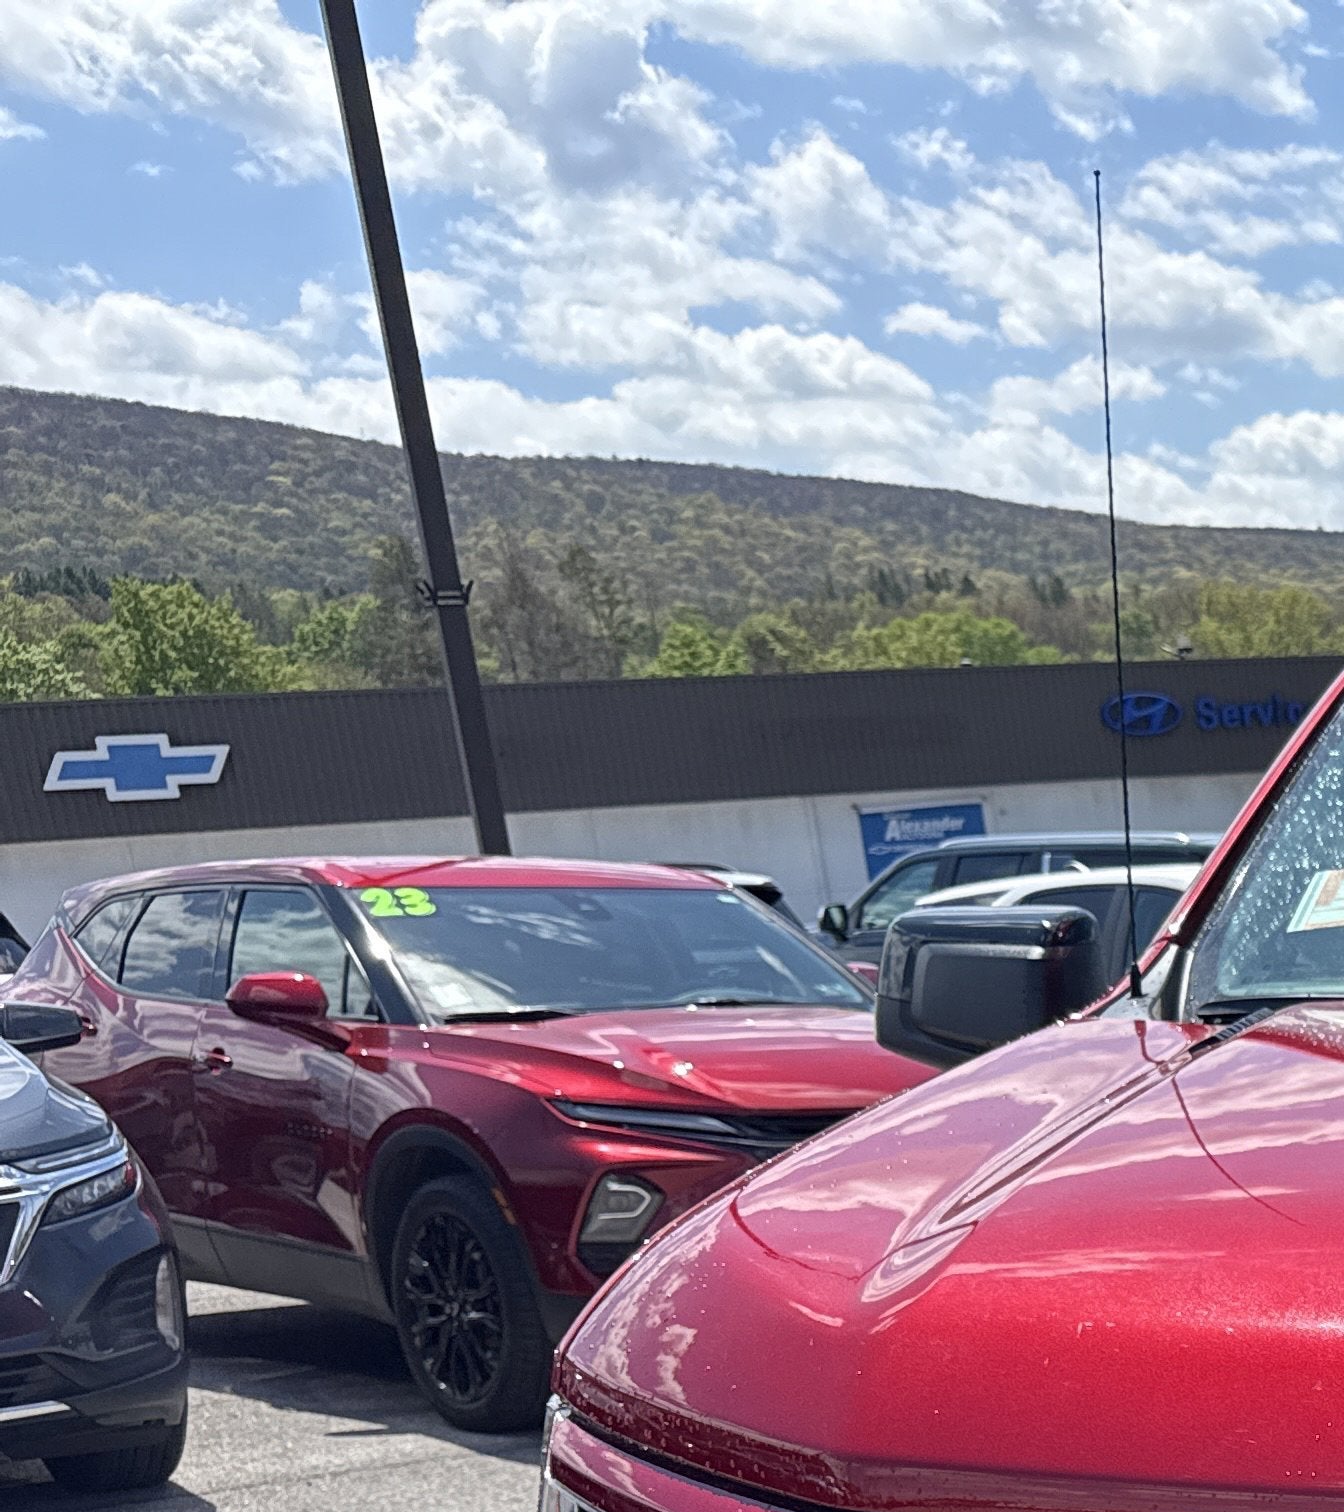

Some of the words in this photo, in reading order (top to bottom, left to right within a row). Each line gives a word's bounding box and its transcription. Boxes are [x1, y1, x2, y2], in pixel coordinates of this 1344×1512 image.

[1196, 692, 1305, 731] Servic
[884, 815, 966, 842] Alexander
[360, 887, 437, 917] 23
